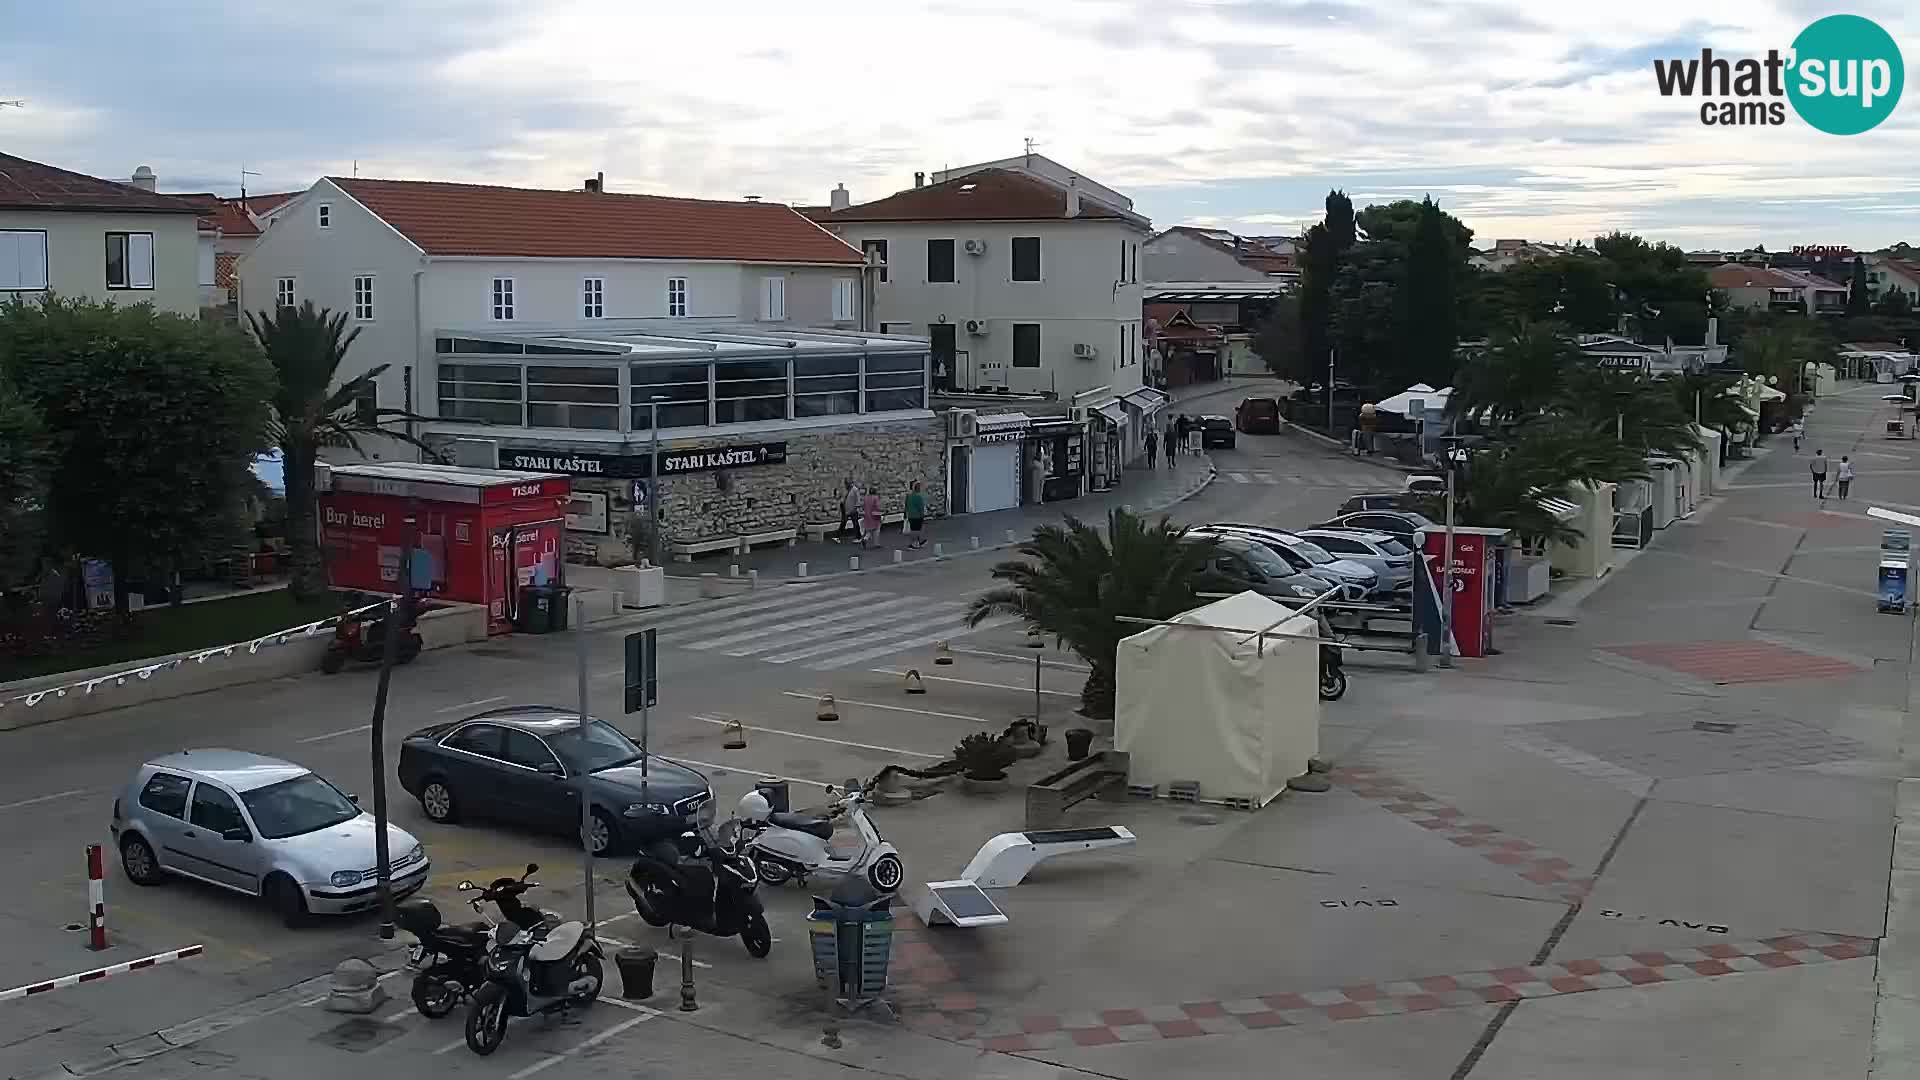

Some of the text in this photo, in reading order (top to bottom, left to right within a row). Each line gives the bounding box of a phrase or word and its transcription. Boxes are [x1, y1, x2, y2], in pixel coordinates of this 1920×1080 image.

[514, 455, 604, 473] STARI KAŠTEL
[664, 449, 757, 471] STARI KAŠTEL
[511, 483, 541, 497] TISAK
[325, 506, 385, 529] Buy here!
